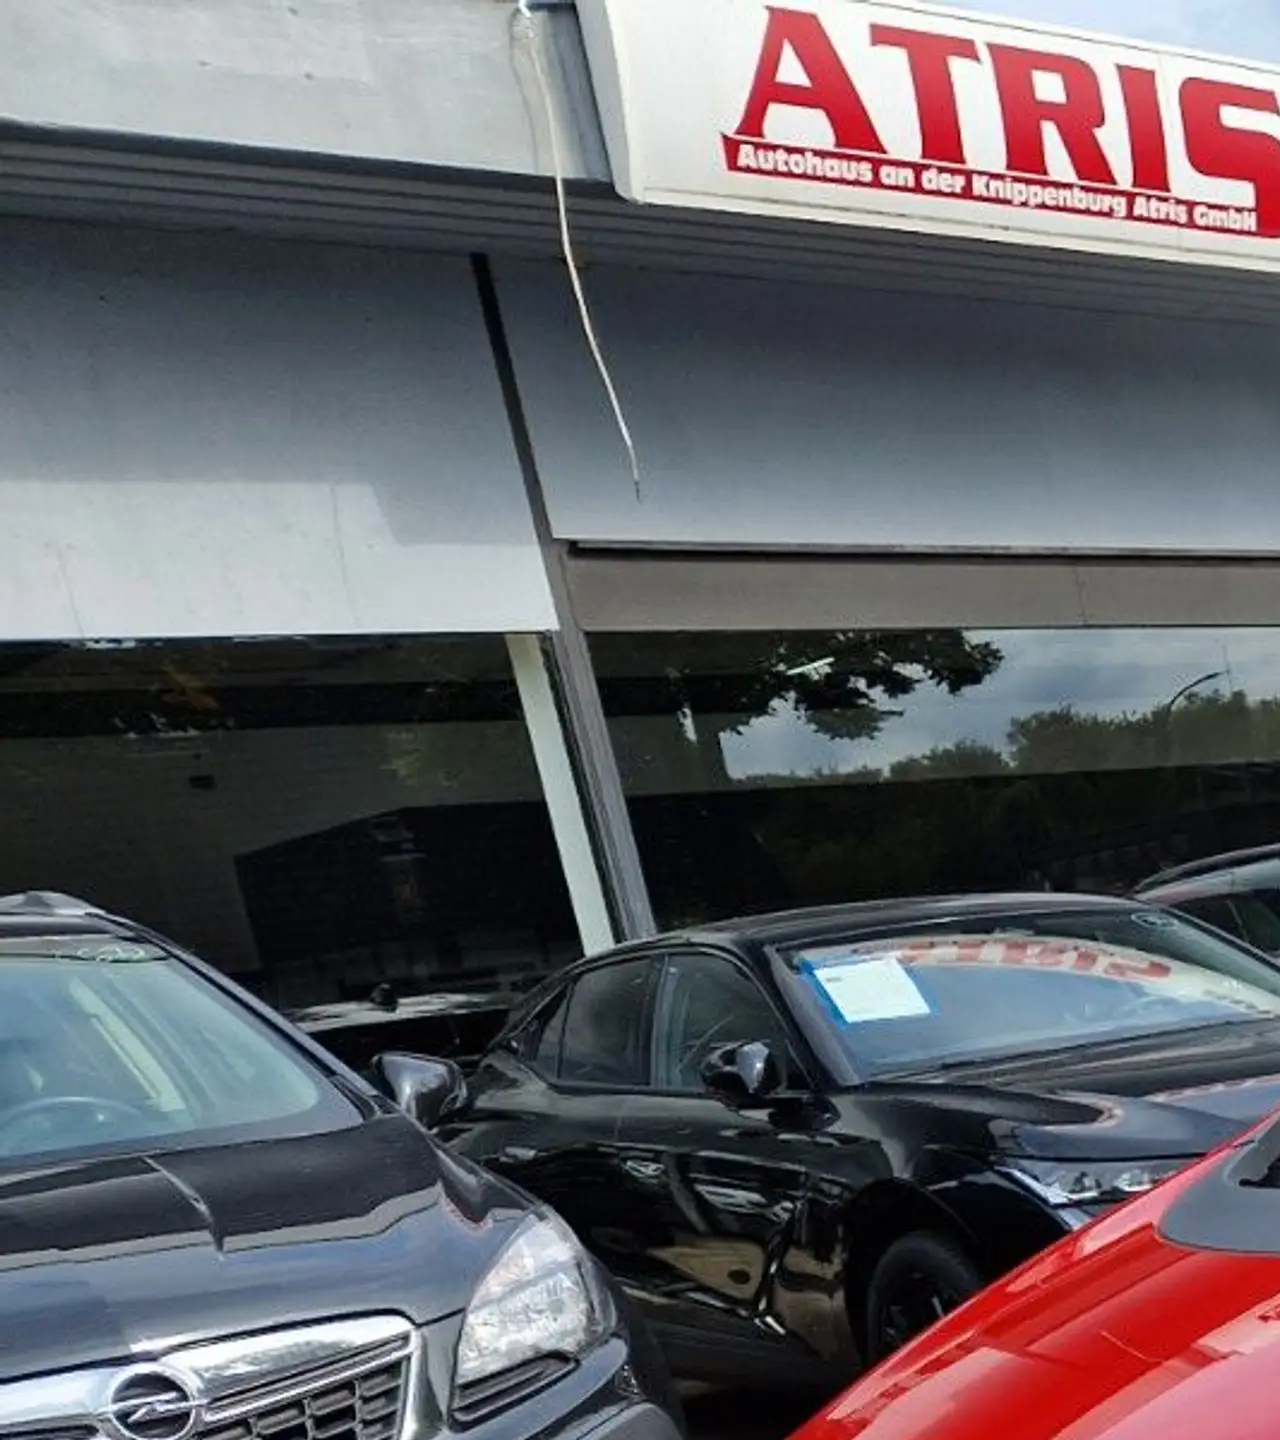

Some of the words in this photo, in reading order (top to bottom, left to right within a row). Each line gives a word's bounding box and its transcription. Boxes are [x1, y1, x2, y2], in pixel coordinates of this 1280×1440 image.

[736, 143, 873, 183] Autohaus
[879, 164, 916, 188] an
[921, 167, 966, 194] der
[972, 171, 1126, 217] Knippenburg
[1133, 195, 1187, 225] Atris
[1193, 206, 1257, 232] GmbH
